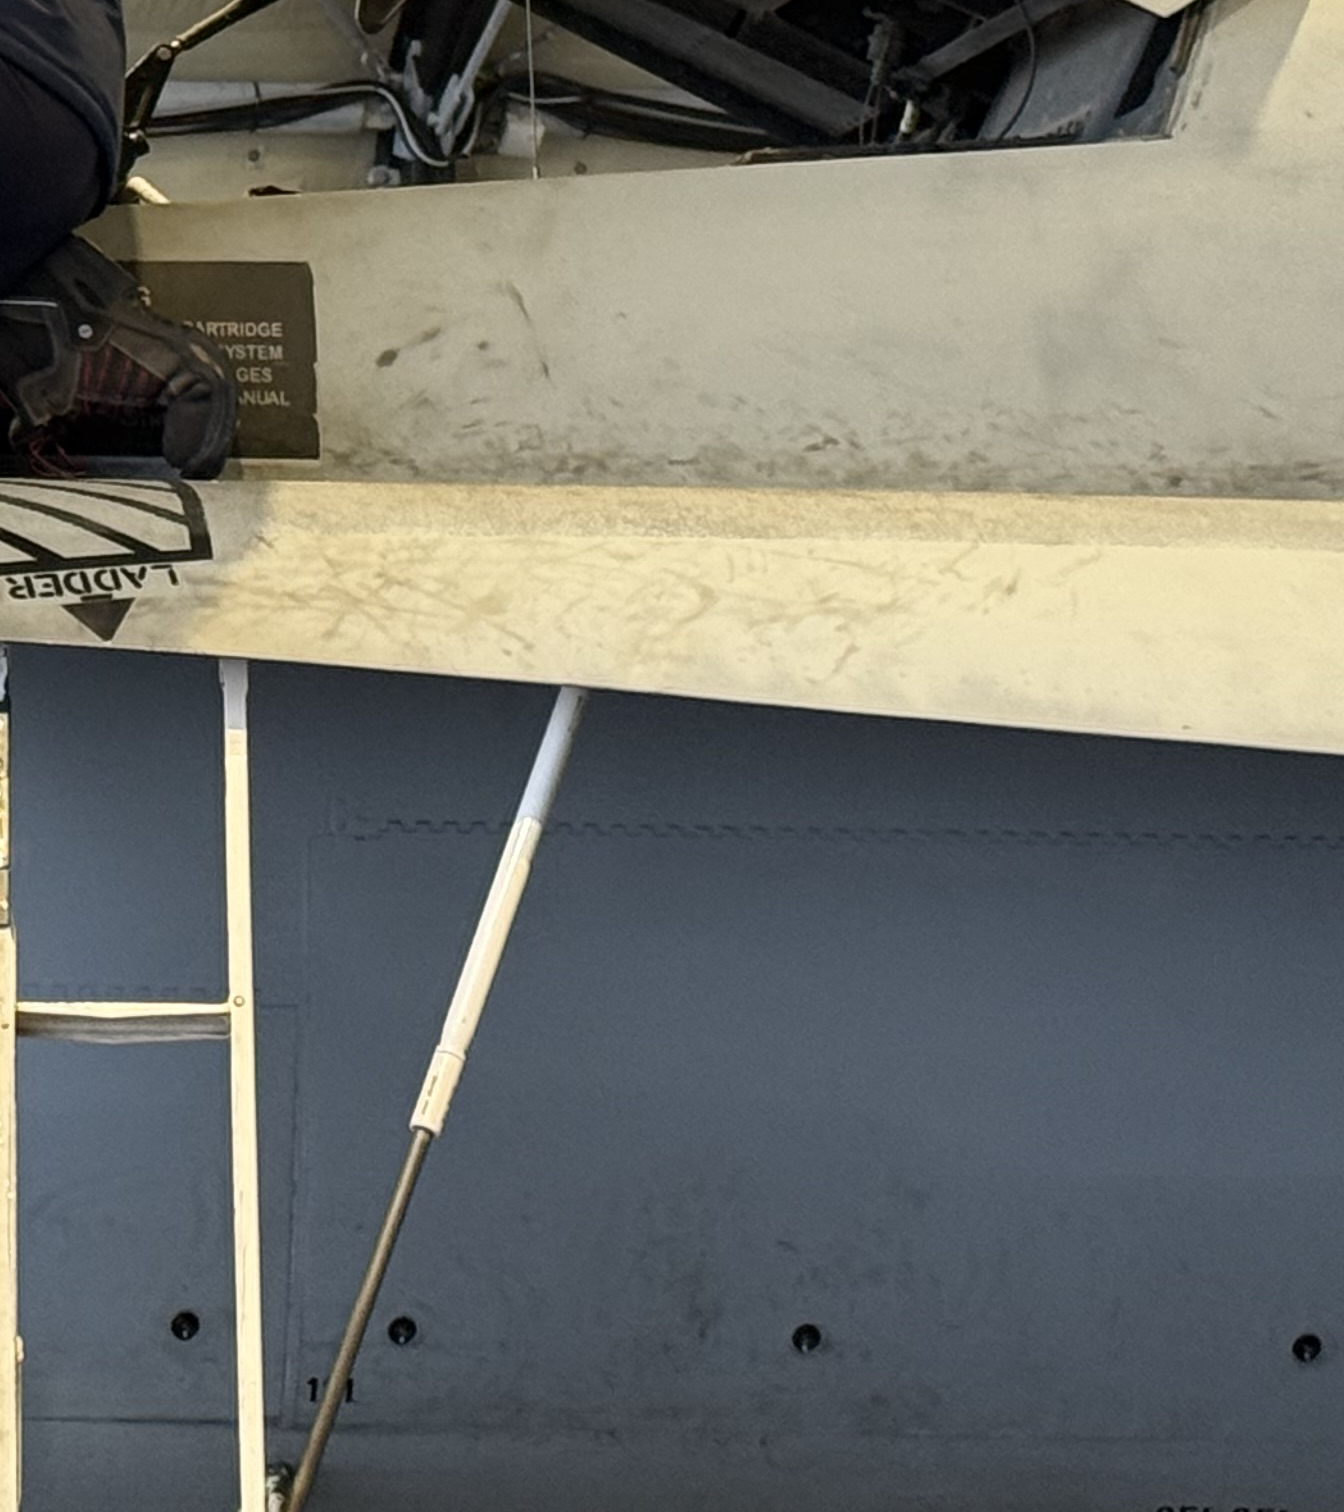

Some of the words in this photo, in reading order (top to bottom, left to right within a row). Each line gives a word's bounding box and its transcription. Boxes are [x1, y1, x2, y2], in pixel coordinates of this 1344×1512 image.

[183, 321, 283, 338] ARTRIDGE
[219, 344, 284, 360] YSTEM
[236, 367, 272, 383] GES
[238, 390, 291, 407] NUAL
[5, 565, 180, 601] LADDER
